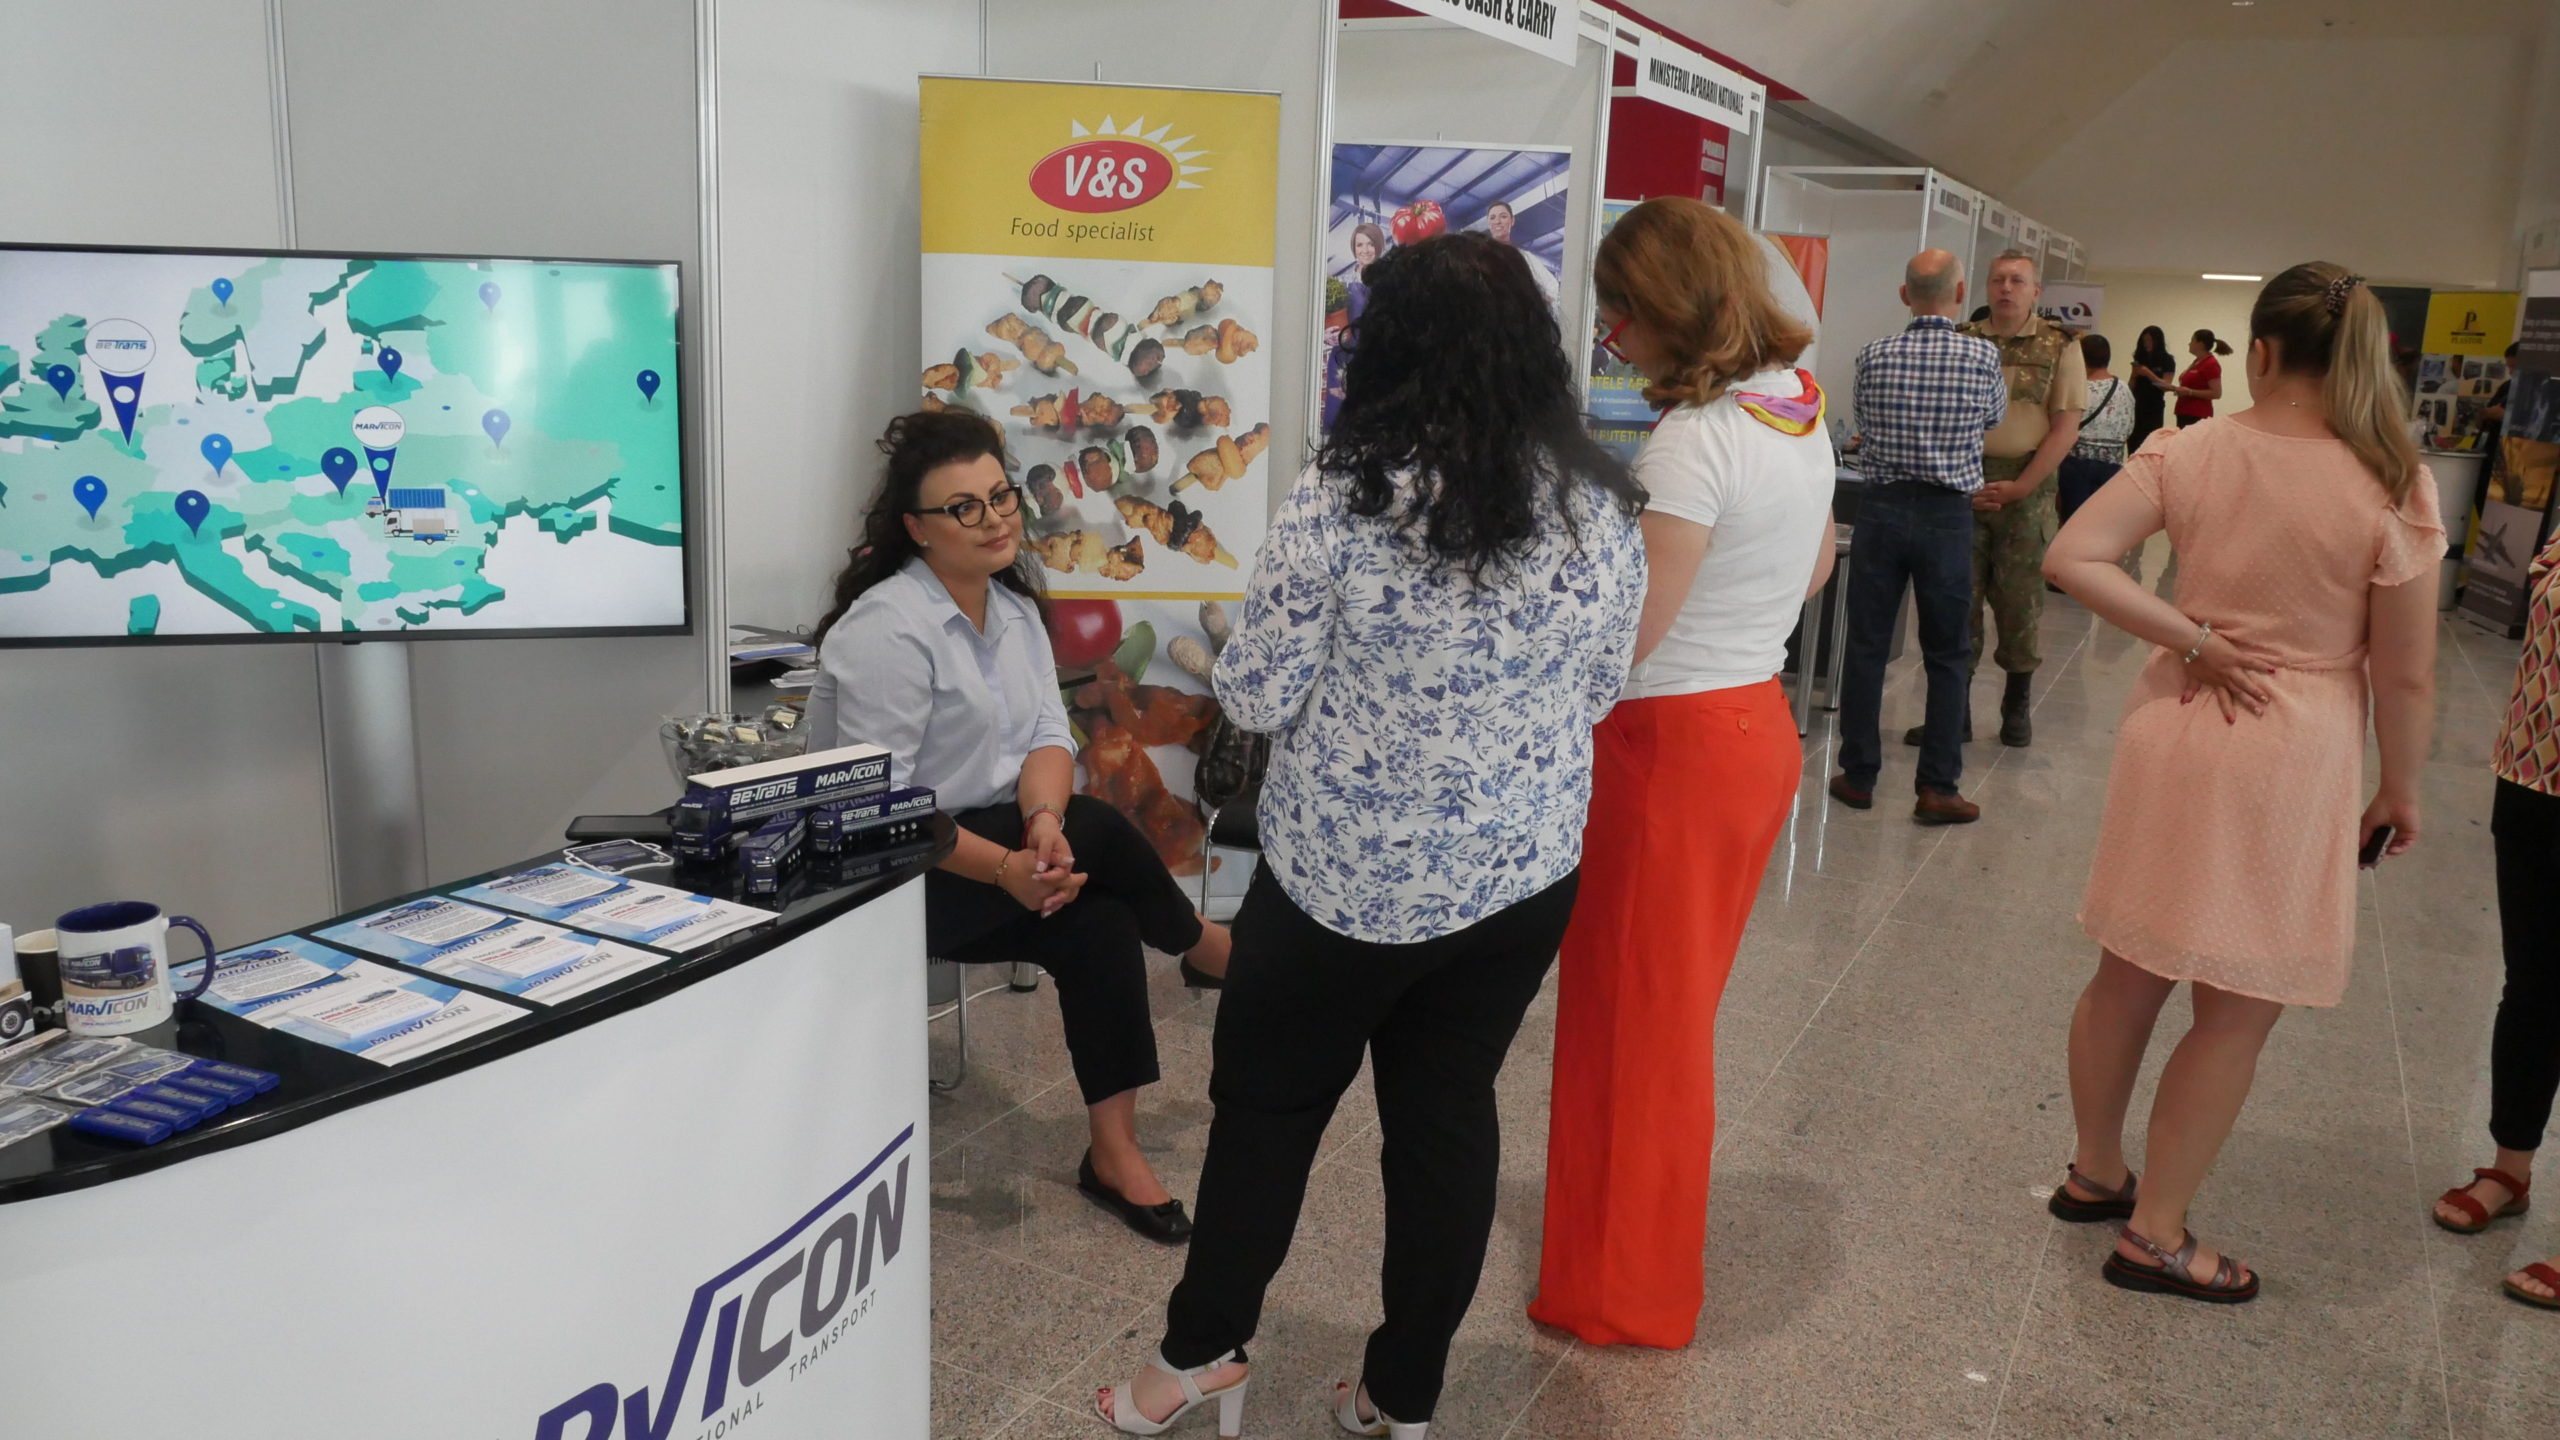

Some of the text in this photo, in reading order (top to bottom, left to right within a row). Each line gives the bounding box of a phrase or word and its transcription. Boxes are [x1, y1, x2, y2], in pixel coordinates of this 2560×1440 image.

[1517, 0, 1557, 40] CARRY
[1649, 57, 1690, 94] MINISTERUL
[1065, 154, 1147, 199] V&S
[1011, 217, 1155, 243] Food specialist
[355, 422, 402, 430] MARVICON
[815, 760, 885, 788] MARVICON
[890, 794, 932, 812] MARVICON
[214, 955, 290, 980] ARVICON
[528, 952, 613, 988] MARVICON
[66, 991, 149, 1015] MARVICON
[369, 1004, 471, 1046] MARVICON
[788, 1289, 877, 1383] TRANSPORT
